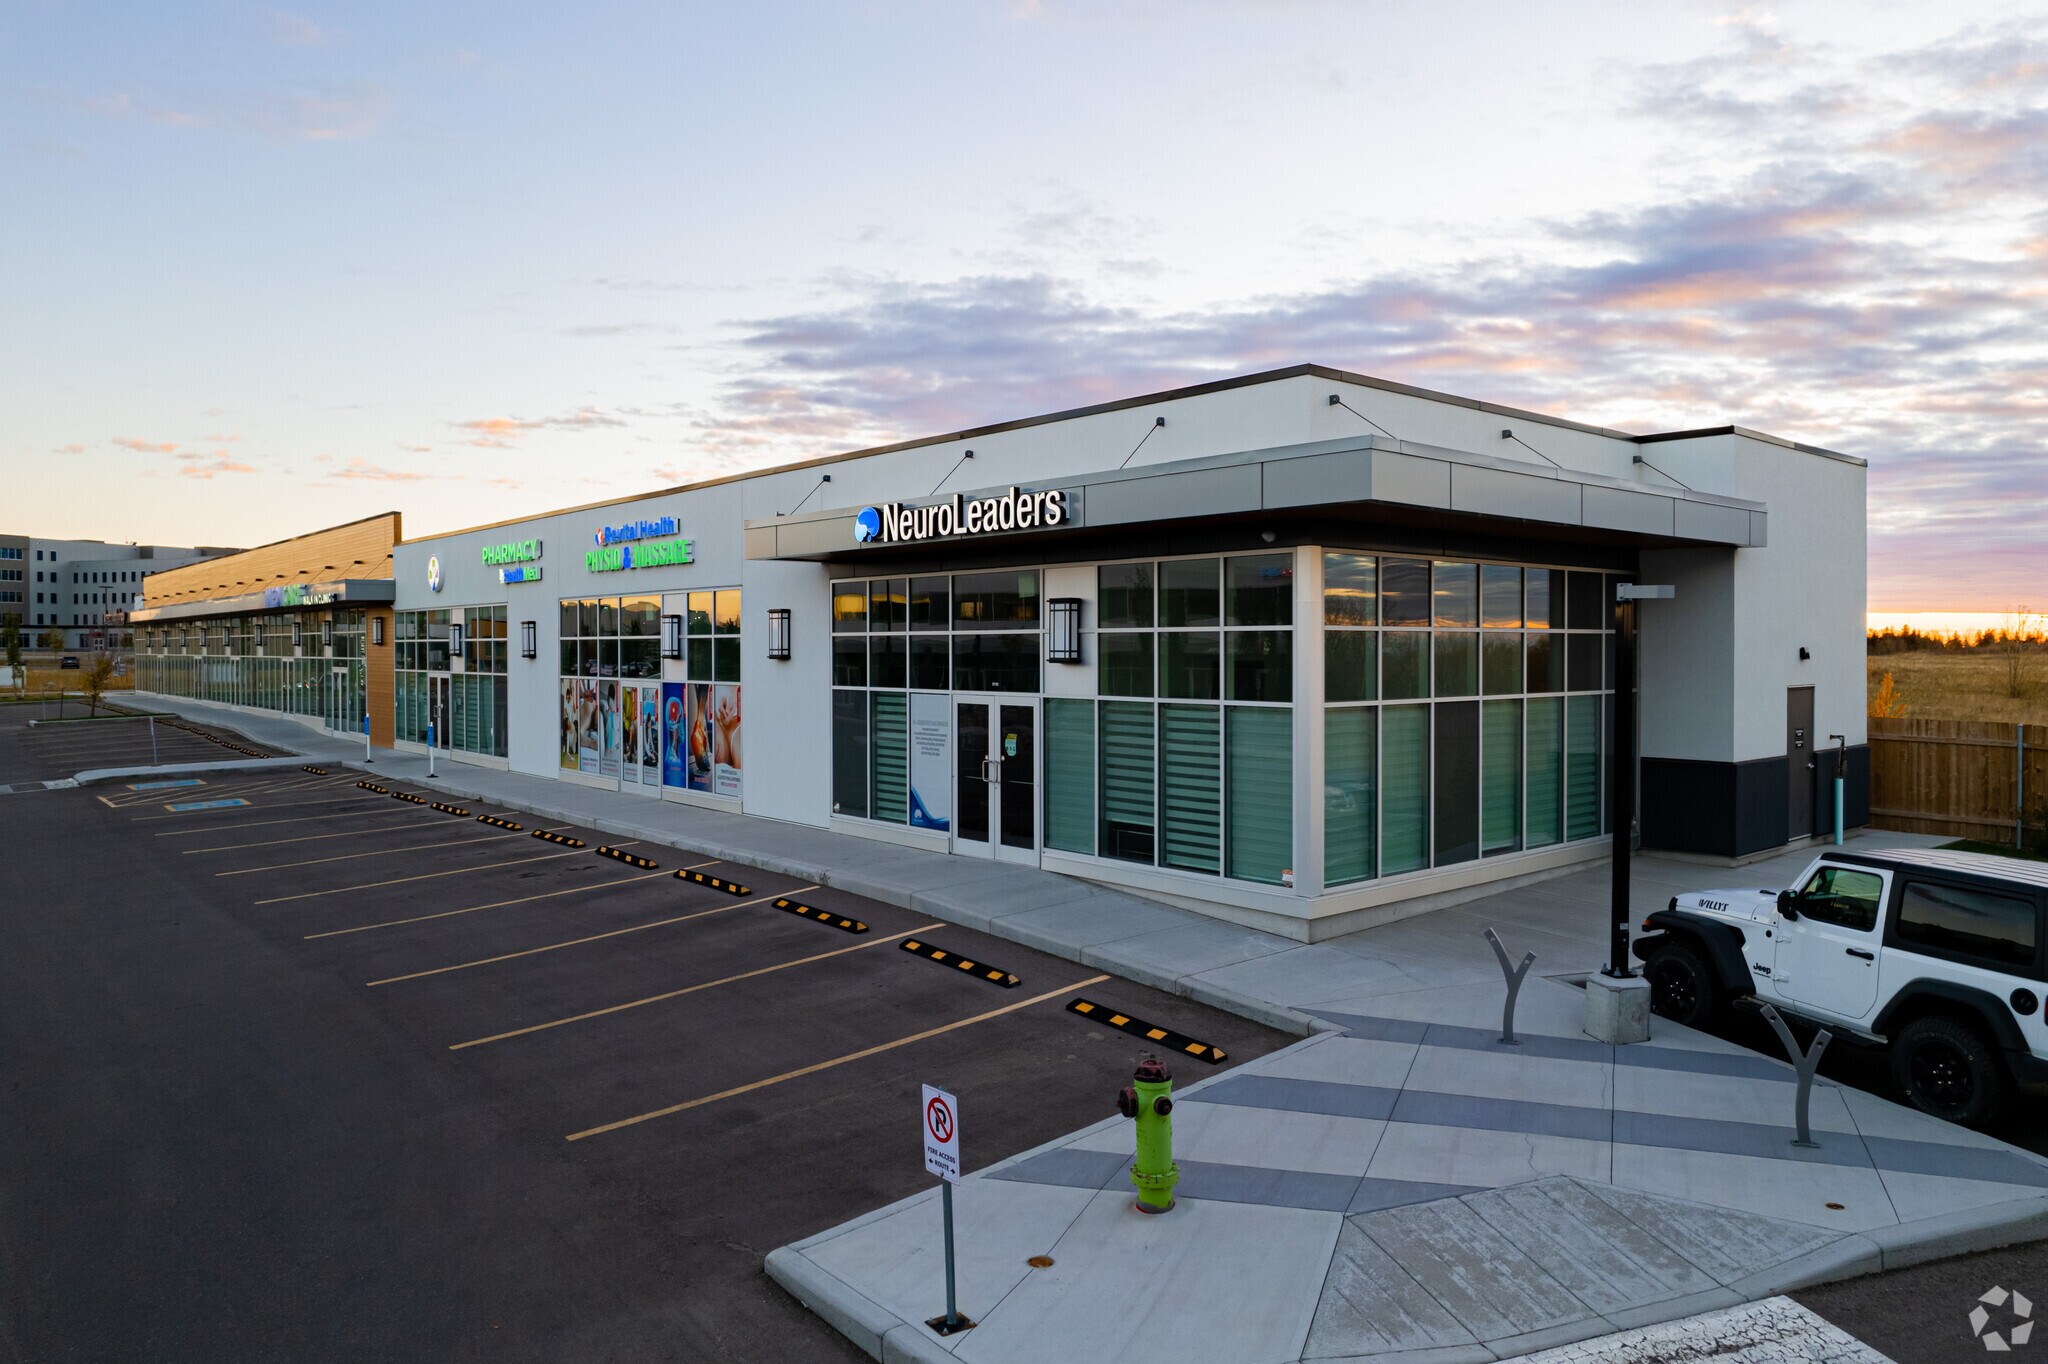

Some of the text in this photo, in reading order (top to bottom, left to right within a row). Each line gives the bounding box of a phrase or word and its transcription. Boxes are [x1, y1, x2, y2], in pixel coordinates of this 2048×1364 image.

[883, 486, 1062, 543] NeuroLeaders
[604, 515, 675, 543] Revital Health
[481, 538, 538, 566] PHARMACY
[585, 538, 689, 572] PHYSIO & MASSAGE
[1698, 898, 1729, 912] WILLYS
[1752, 962, 1771, 975] Jeep
[927, 1145, 956, 1164] FIRE ACCESS
[934, 1159, 949, 1172] ROUTE
